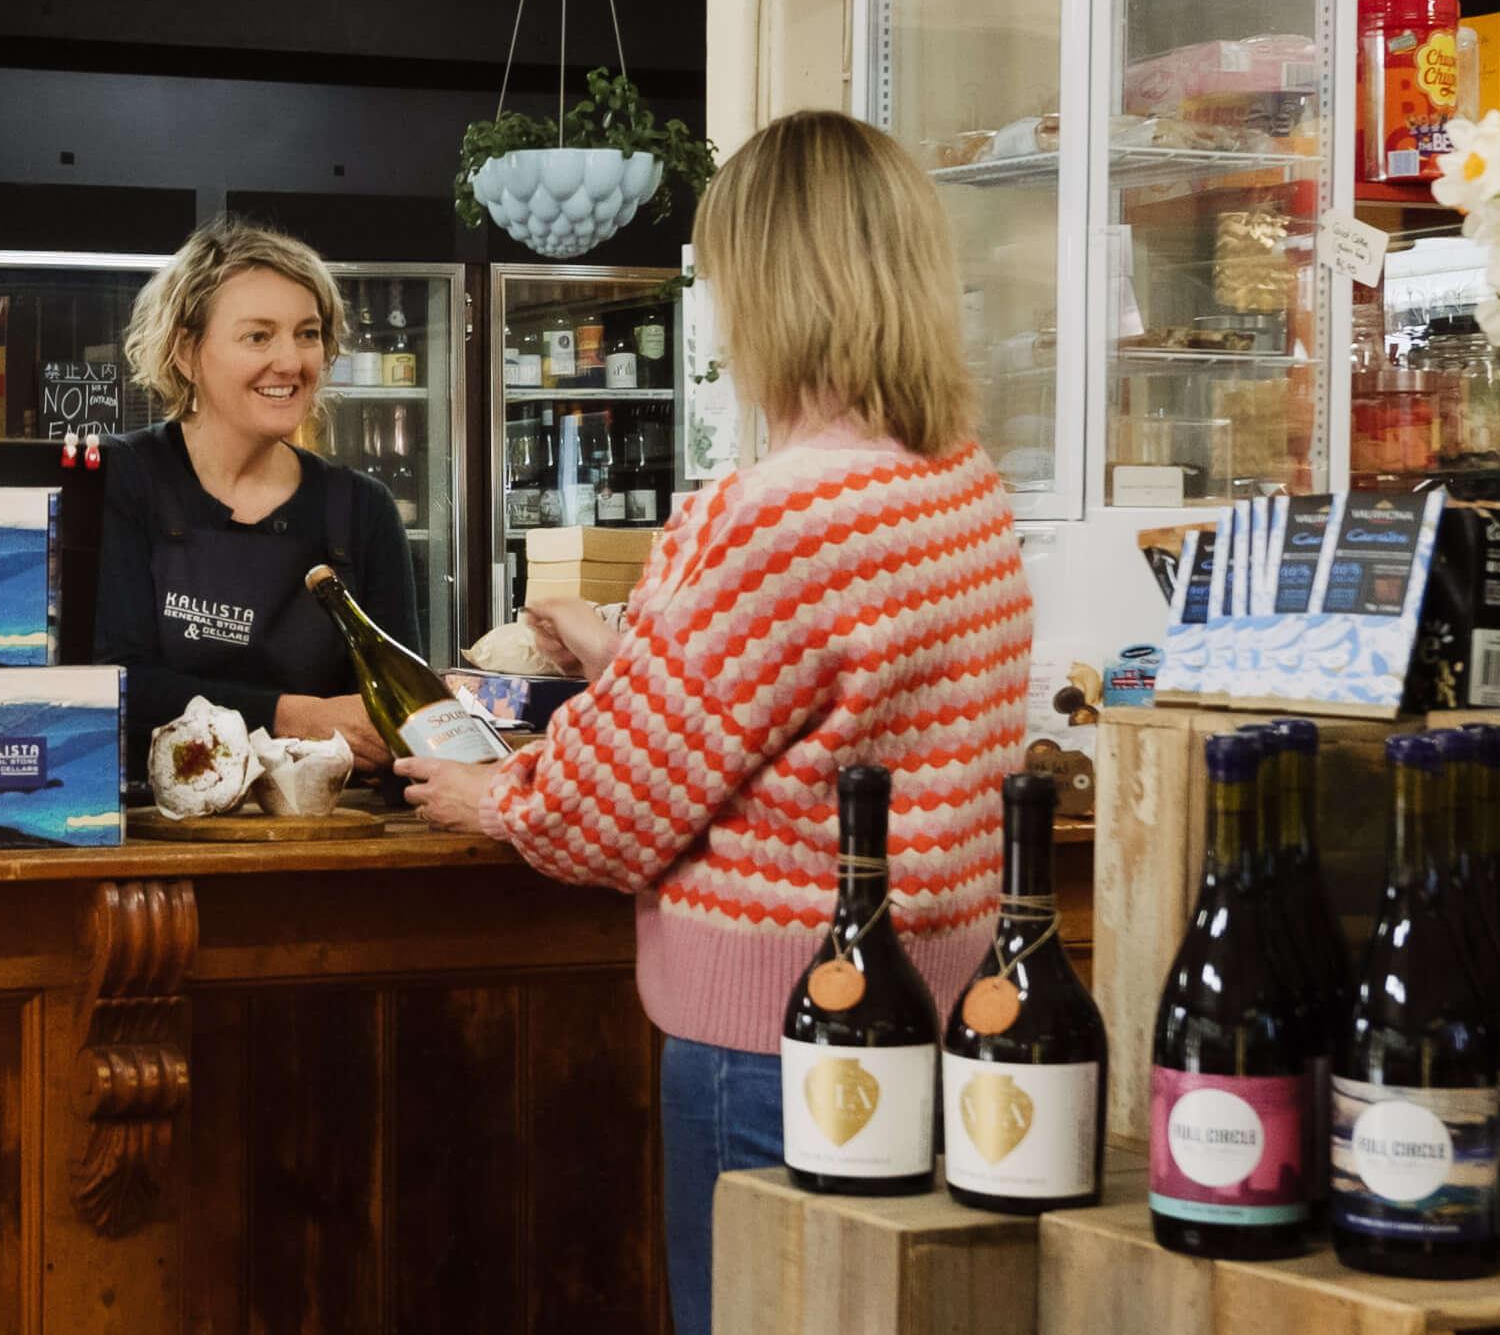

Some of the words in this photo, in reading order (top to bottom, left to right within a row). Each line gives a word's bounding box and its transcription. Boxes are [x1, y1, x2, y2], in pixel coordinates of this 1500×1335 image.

[44, 384, 82, 420] NO
[165, 591, 255, 622] KALLISTA
[184, 623, 201, 642] &
[201, 626, 250, 643] CELLARS
[0, 765, 39, 773] CELLARS
